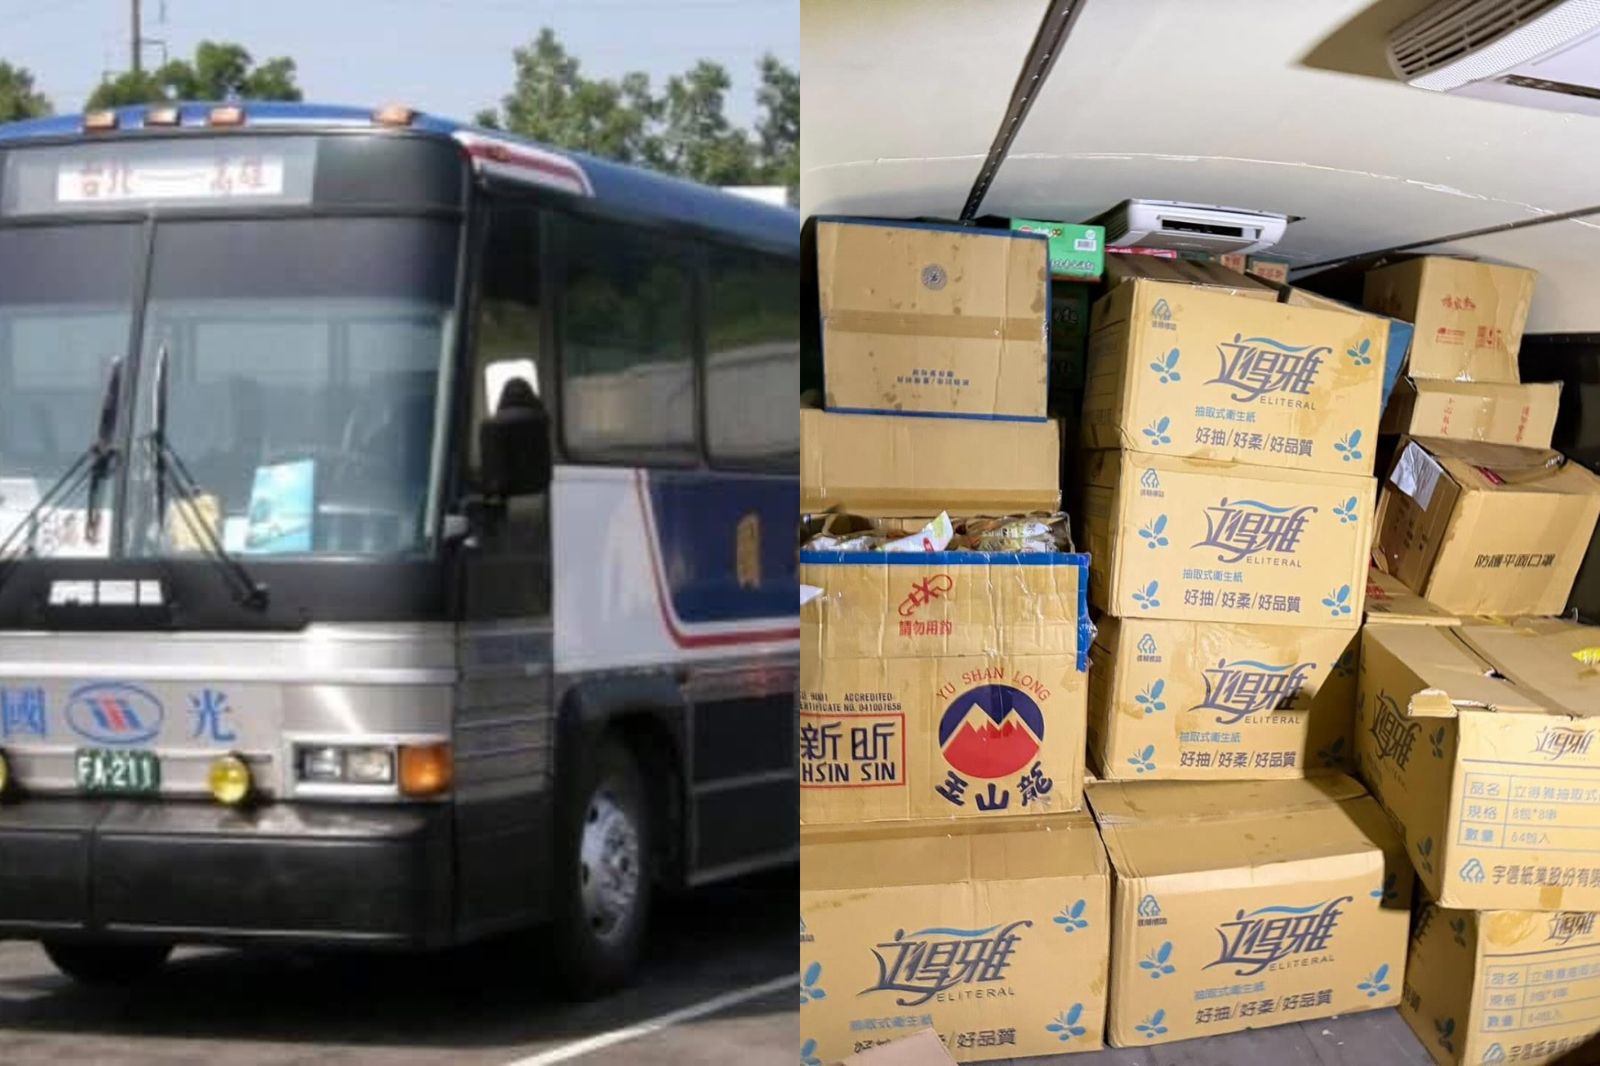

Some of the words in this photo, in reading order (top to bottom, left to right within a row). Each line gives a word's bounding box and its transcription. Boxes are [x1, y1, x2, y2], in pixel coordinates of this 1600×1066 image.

[1259, 397, 1317, 411] ELITERAL
[1194, 405, 1257, 424] 抽取式衛生紙
[1194, 426, 1314, 458] 好抽/好柔/好品質
[1246, 555, 1303, 568] ELITERAL
[1473, 553, 1557, 569] 防護平面口罩
[1182, 568, 1244, 583] 抽取式衛生紙
[1183, 588, 1301, 614] 好抽/好柔/好品質
[936, 682, 957, 702] YU
[961, 666, 1006, 685] SHAN
[1011, 671, 1051, 703] LONG
[844, 692, 893, 702] ACCREDITED
[187, 688, 238, 743] 光
[1244, 715, 1301, 725] ELITERAL
[1179, 750, 1297, 769] 好抽/好柔/好品質
[802, 762, 850, 784] HSIN
[860, 761, 896, 782] SIN
[1514, 785, 1600, 802] 立得雅抽取式
[1268, 953, 1336, 972] ELITERAL
[936, 986, 1016, 1002] ELITERAL
[1194, 989, 1334, 1024] 好抽/好柔/好品質
